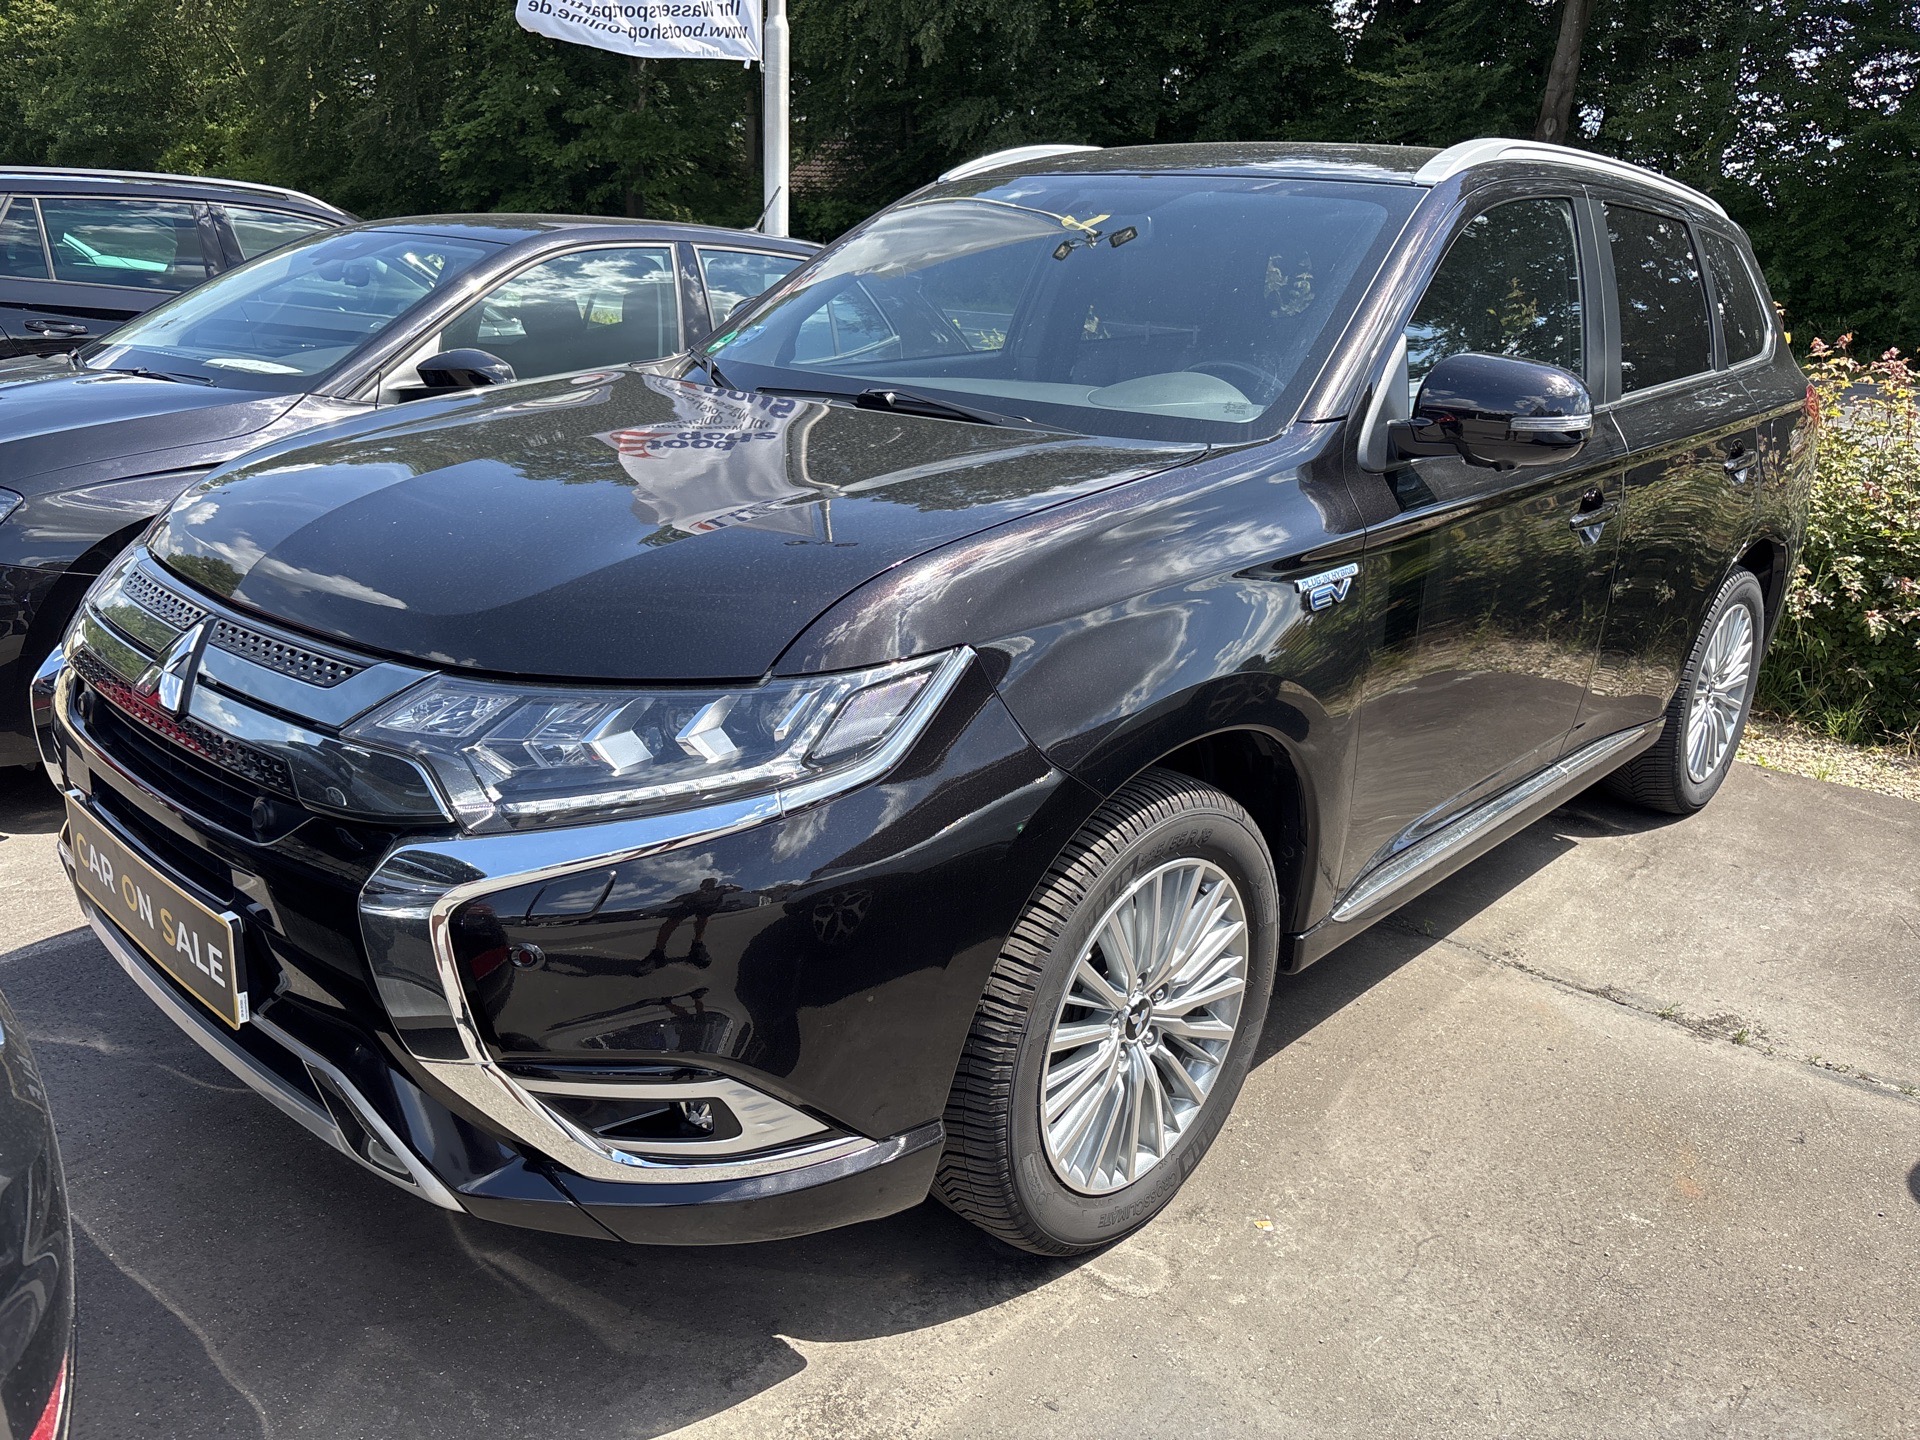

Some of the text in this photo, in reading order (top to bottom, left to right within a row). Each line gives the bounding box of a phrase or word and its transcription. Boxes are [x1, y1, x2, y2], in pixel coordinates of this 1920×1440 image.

[1331, 565, 1356, 580] HYBRID
[1310, 577, 1352, 612] EV
[76, 832, 226, 988] CAR ON SALE
